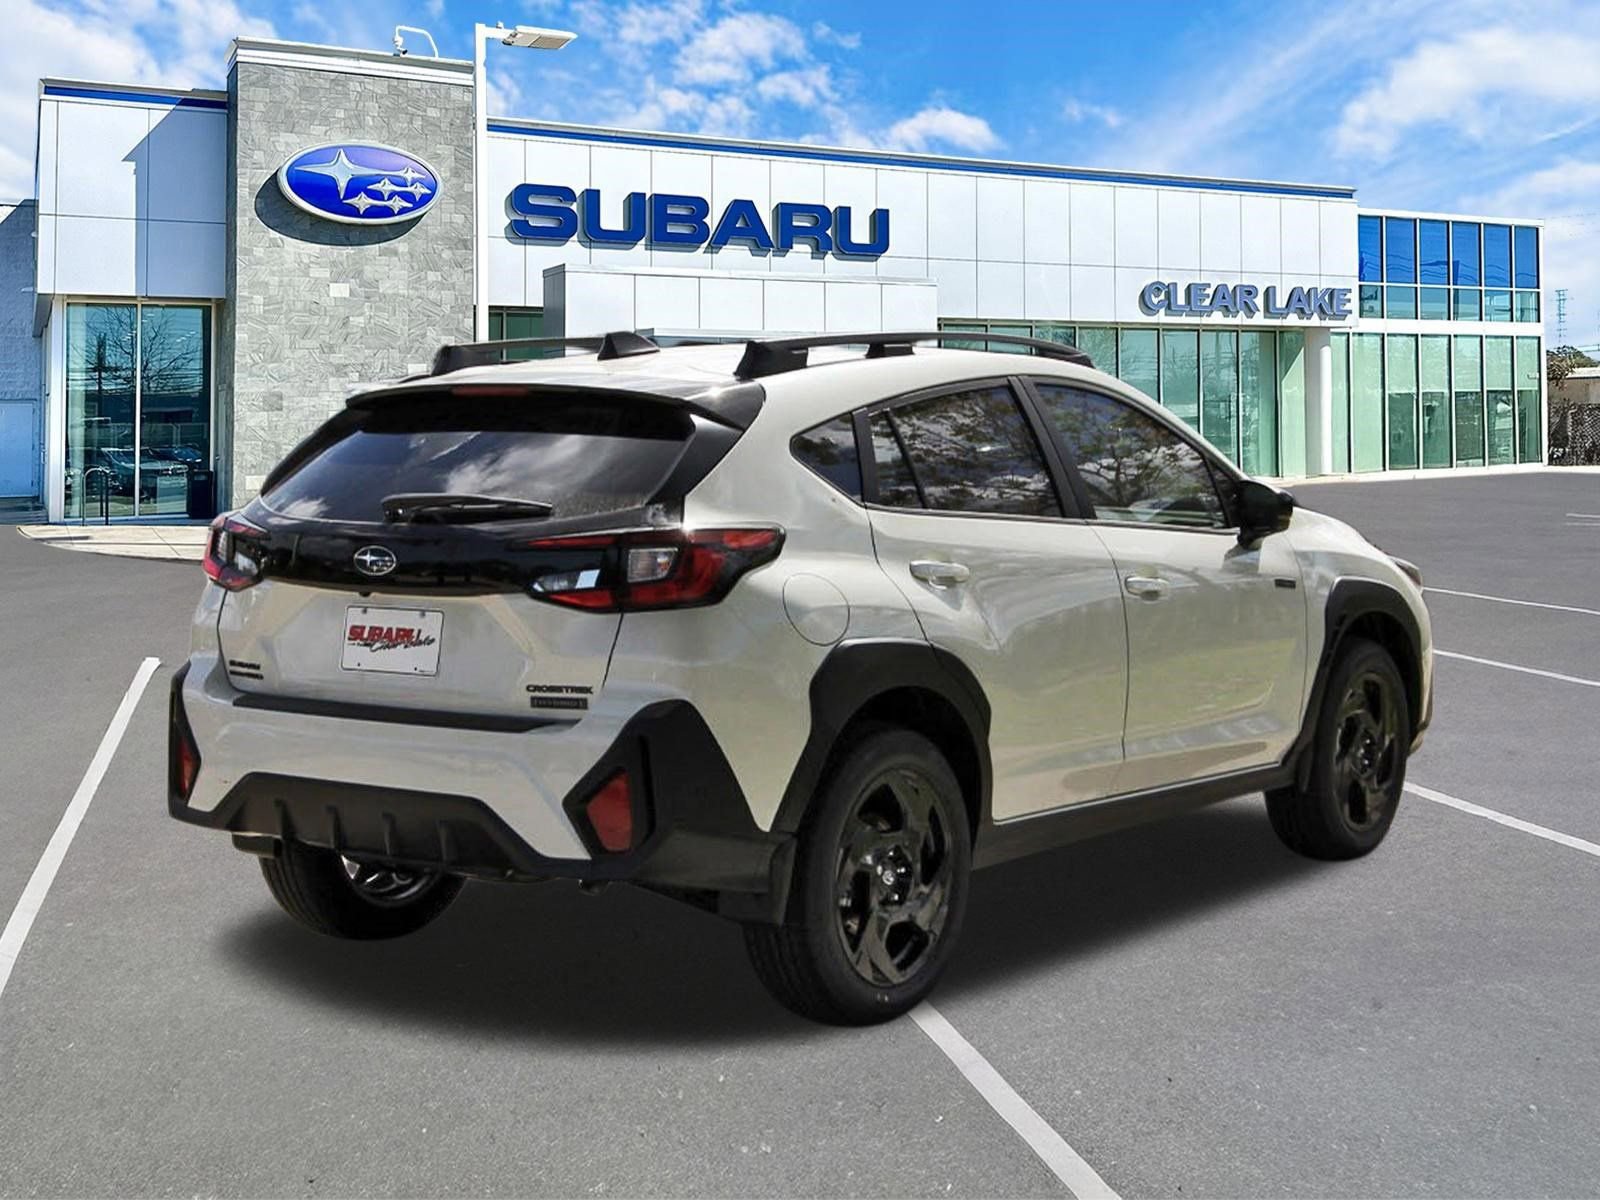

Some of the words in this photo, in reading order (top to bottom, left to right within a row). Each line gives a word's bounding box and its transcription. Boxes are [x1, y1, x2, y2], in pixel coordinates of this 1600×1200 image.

[505, 183, 890, 258] SUBARU
[1139, 281, 1260, 318] CLEAR
[1263, 286, 1353, 320] LAKE
